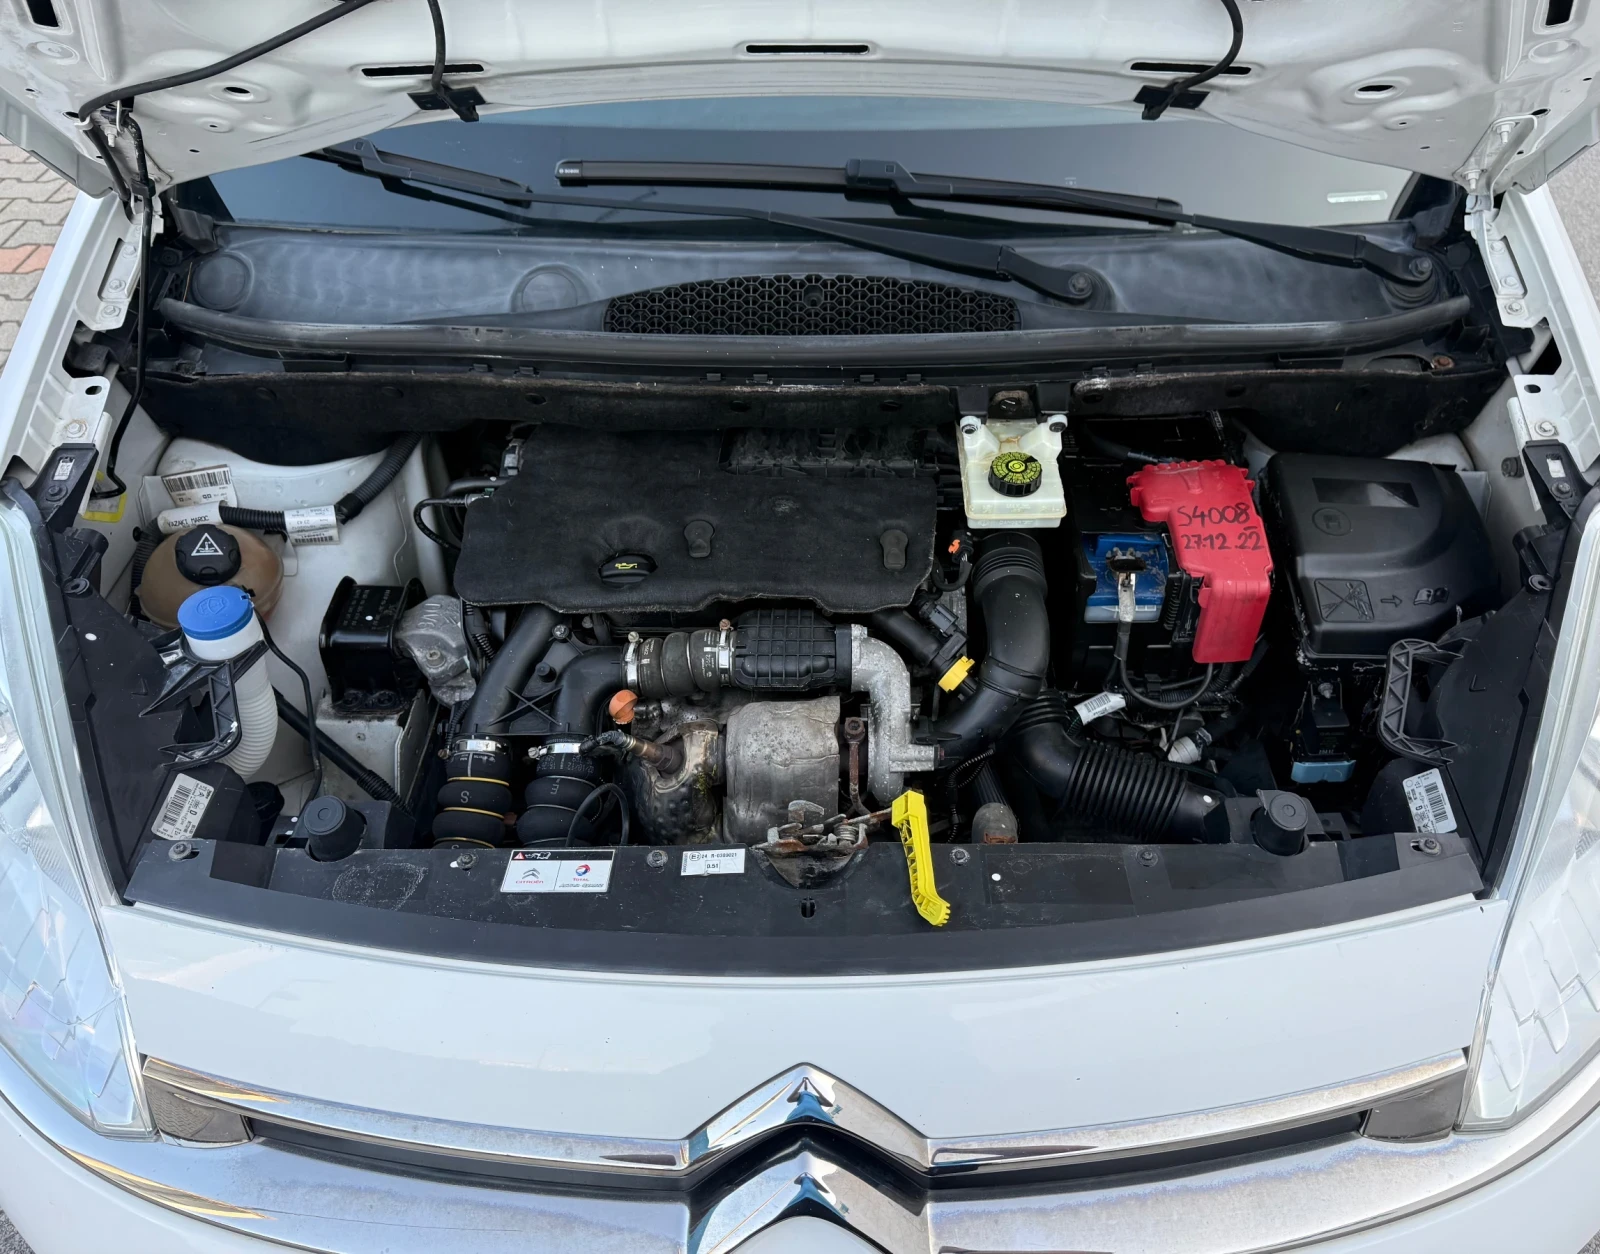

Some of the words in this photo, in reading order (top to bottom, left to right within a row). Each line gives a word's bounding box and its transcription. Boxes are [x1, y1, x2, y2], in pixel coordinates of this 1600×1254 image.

[1177, 502, 1250, 528] S4008
[167, 518, 189, 528] YAZAKI
[460, 790, 470, 804] S
